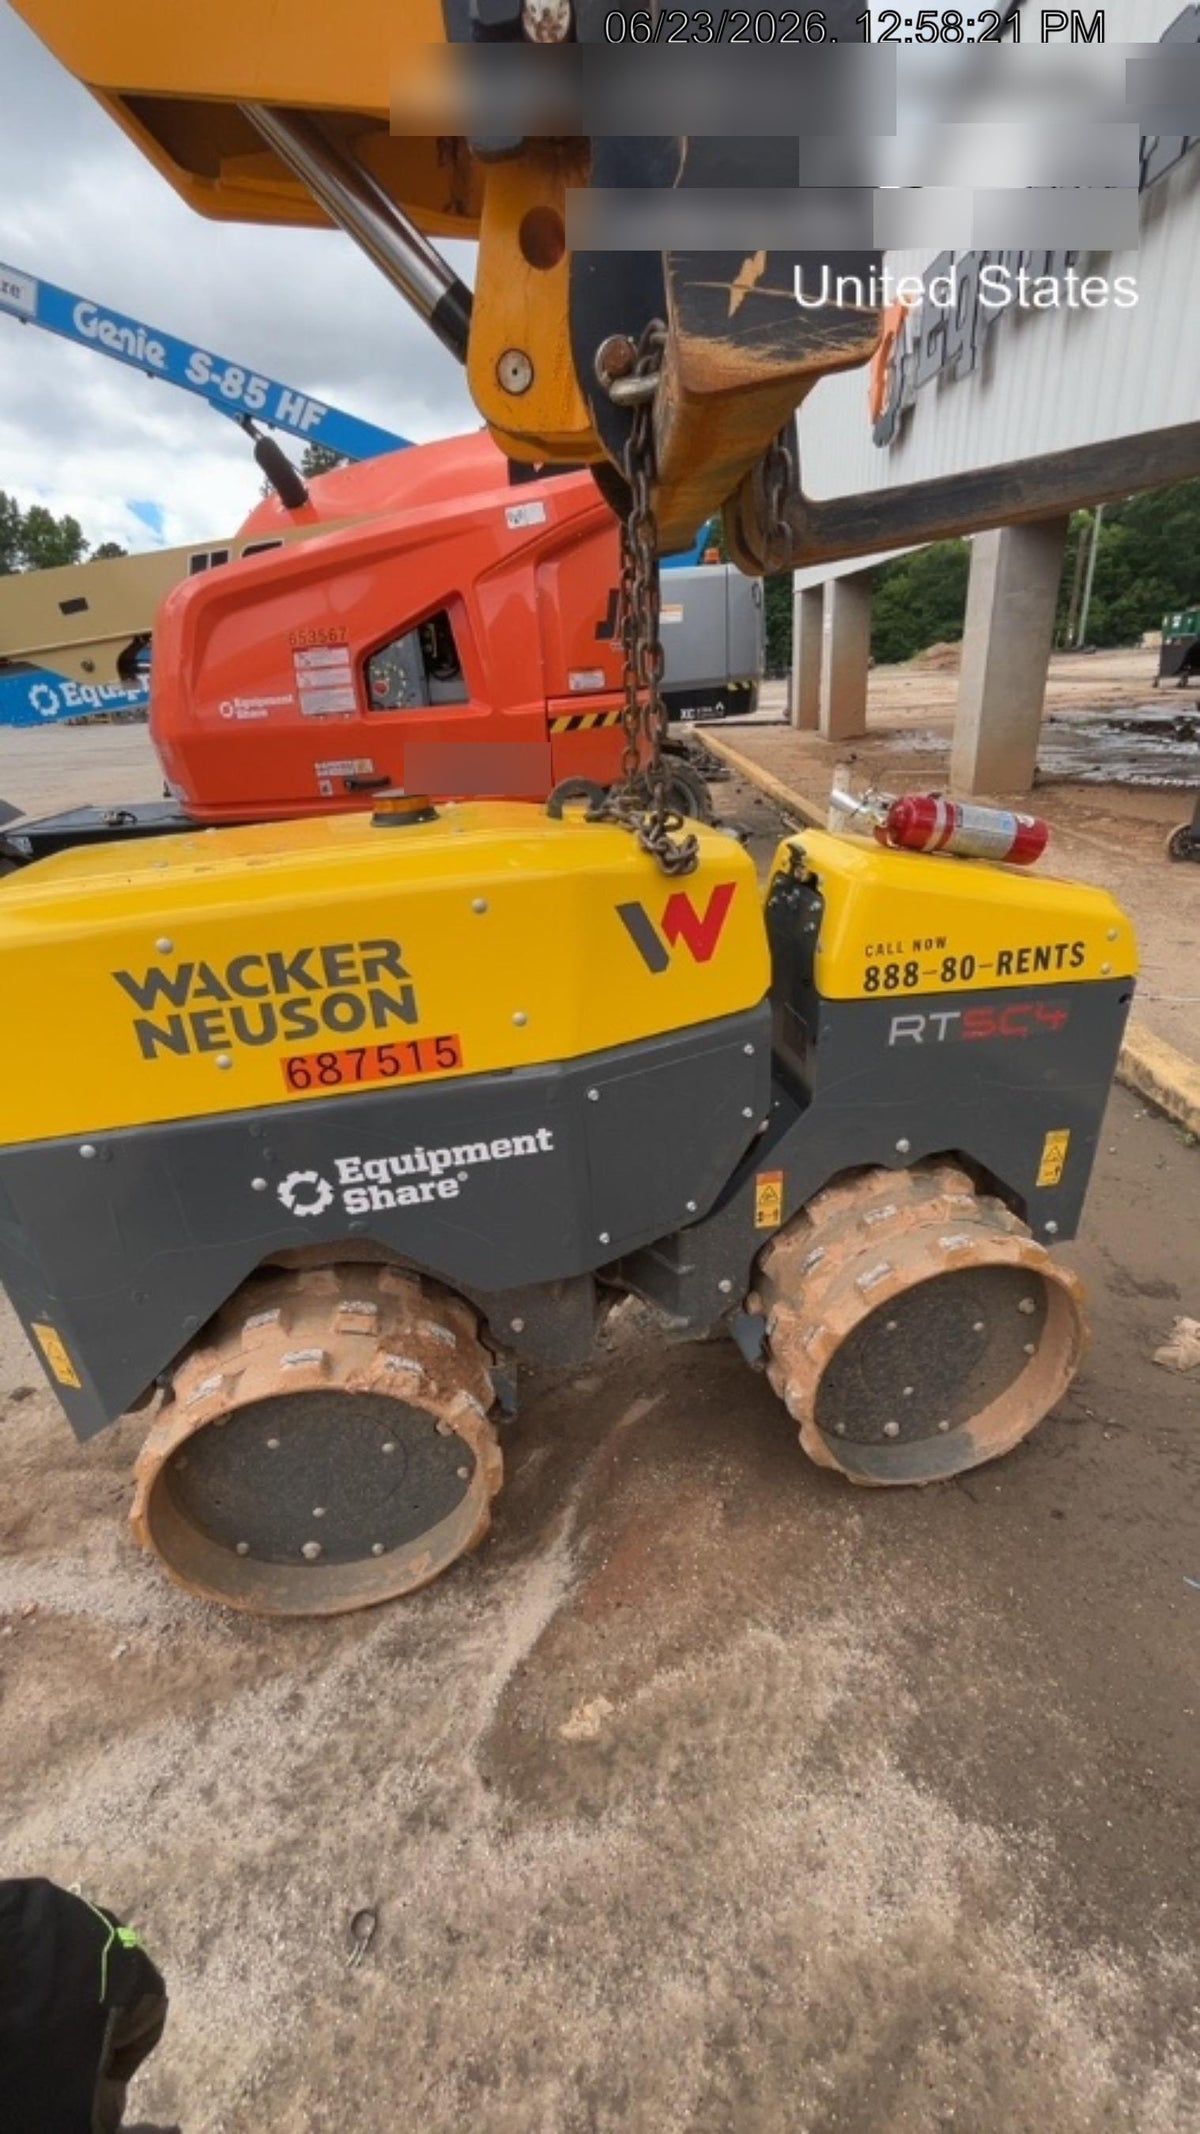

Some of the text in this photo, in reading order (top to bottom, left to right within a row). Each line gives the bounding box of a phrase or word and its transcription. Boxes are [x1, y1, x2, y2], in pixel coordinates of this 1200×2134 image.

[73, 301, 328, 432] Genie S-85 HF
[110, 938, 411, 1011] WACKER
[864, 936, 948, 958] CALL NOW
[864, 941, 1085, 992] 888-80-RENTS
[132, 984, 419, 1060] NEUSON
[286, 1035, 458, 1090] 687515
[334, 1128, 554, 1184] Equipment
